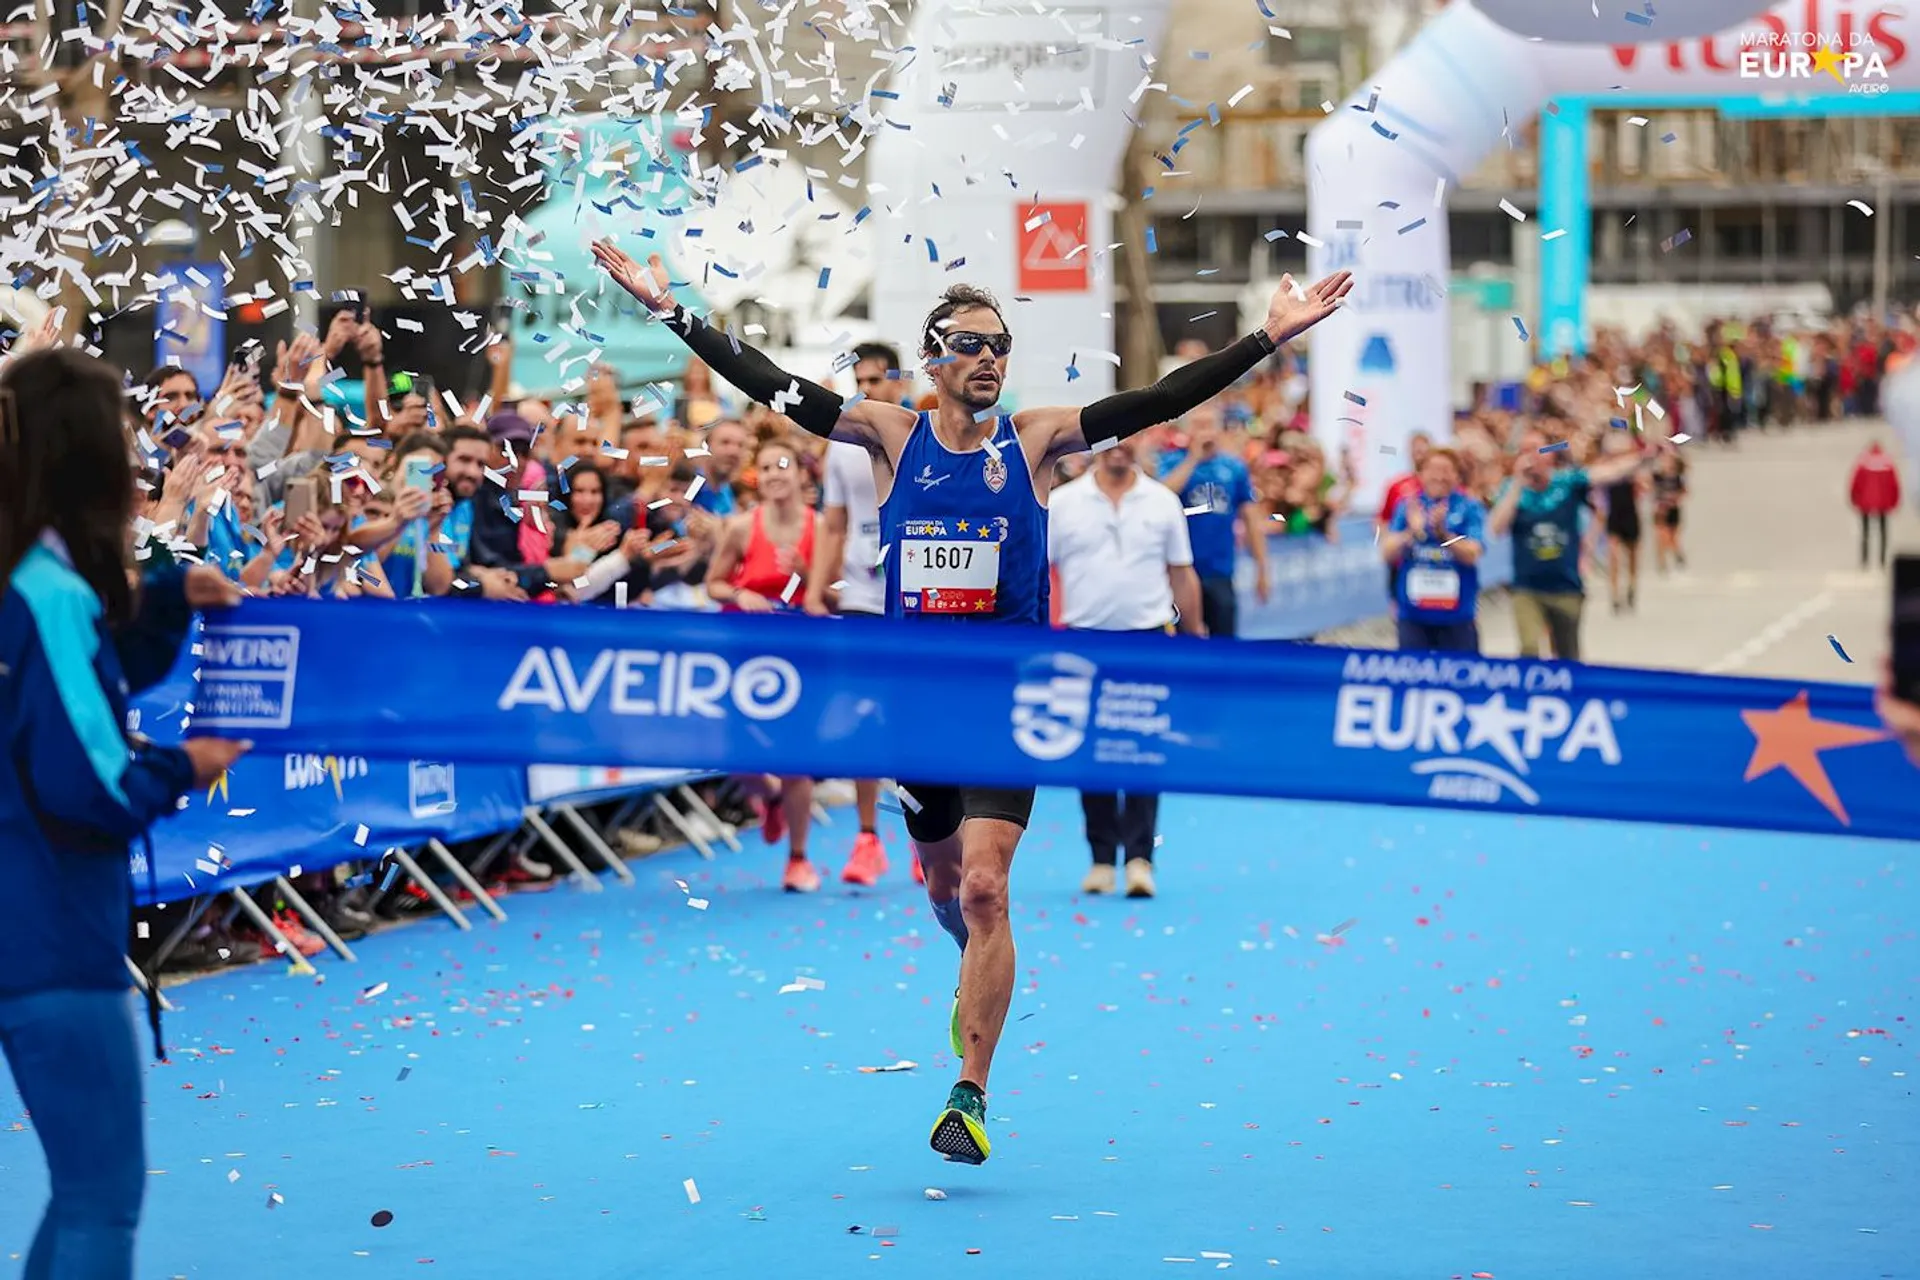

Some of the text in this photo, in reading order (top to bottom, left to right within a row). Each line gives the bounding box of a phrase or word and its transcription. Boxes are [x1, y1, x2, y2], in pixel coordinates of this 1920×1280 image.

[905, 525, 947, 536] EURPA
[923, 546, 974, 570] 1607
[904, 596, 918, 608] VIP
[496, 646, 802, 721] AVEIRO
[1341, 652, 1573, 692] MARATONA DA
[1332, 684, 1623, 771] EURPA
